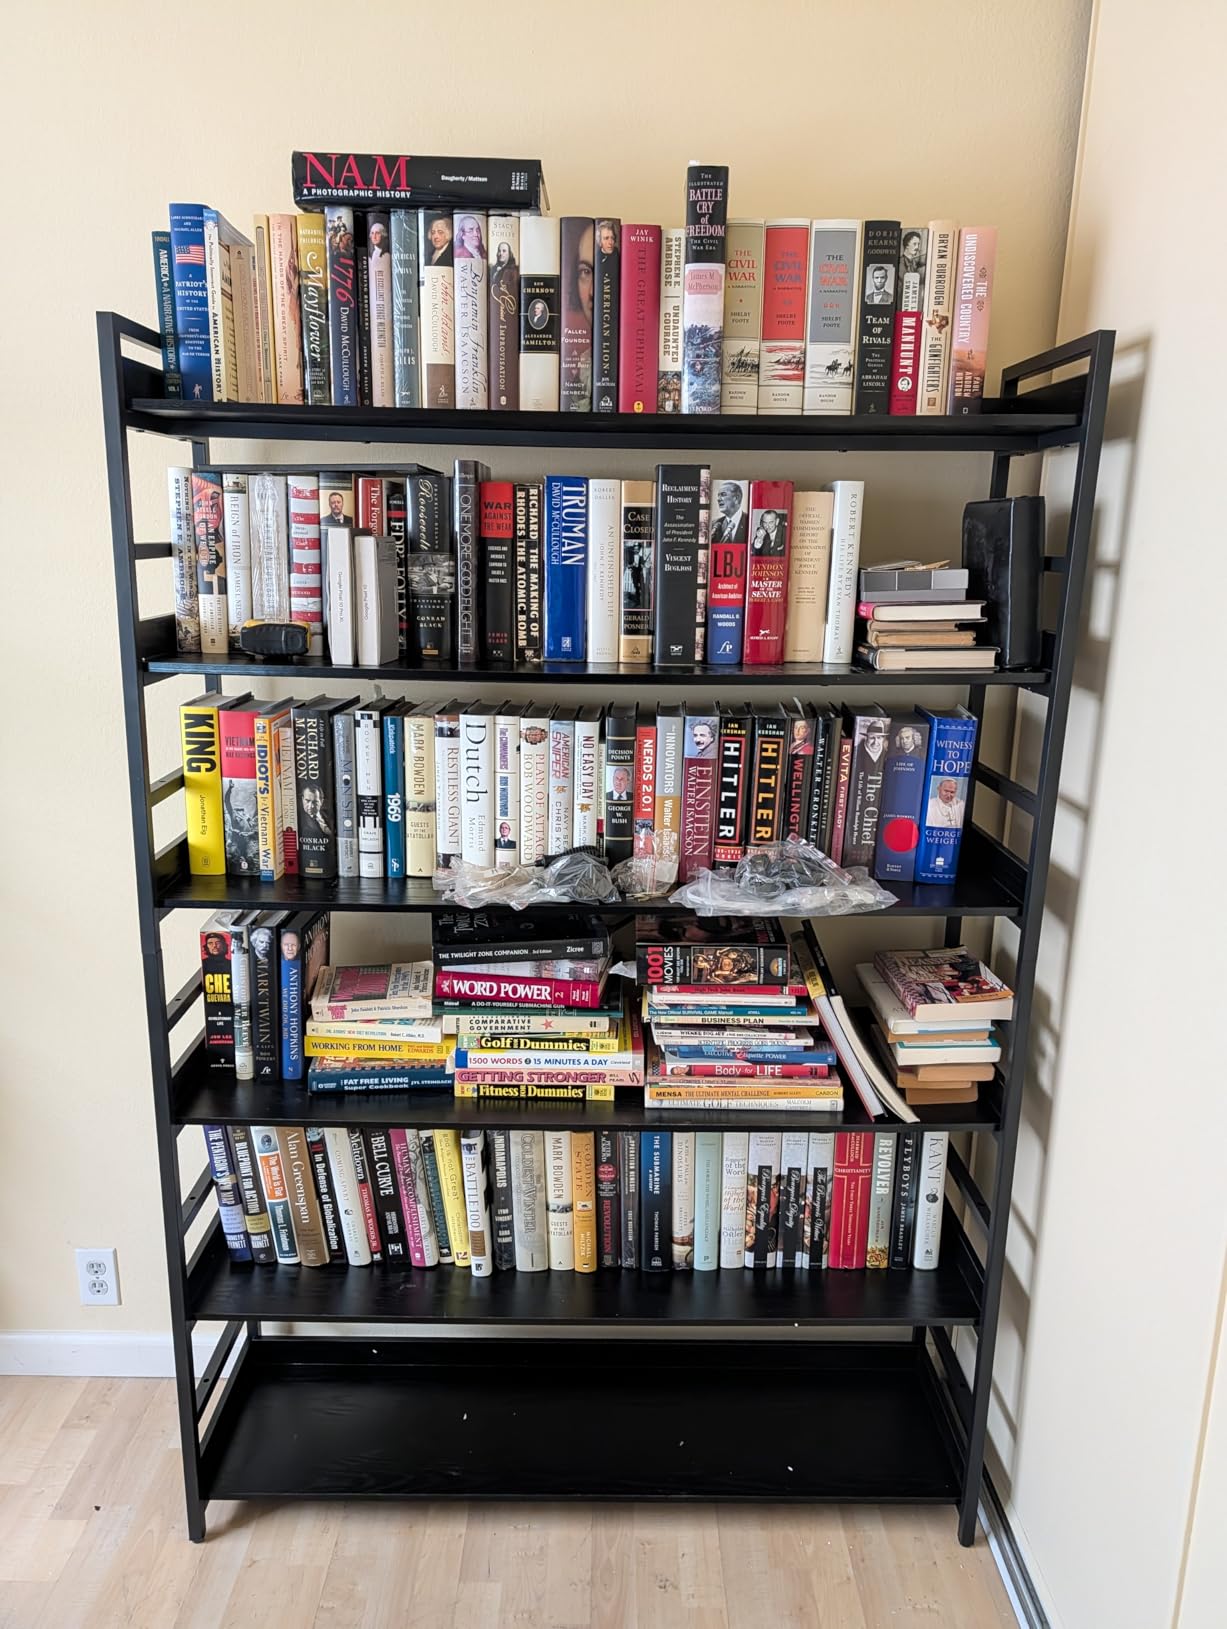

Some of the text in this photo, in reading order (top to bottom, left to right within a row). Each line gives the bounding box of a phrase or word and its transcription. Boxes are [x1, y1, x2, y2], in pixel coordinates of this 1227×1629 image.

[303, 153, 411, 190] NAM
[312, 189, 373, 197] PHOTOGRAPHIC
[690, 190, 722, 200] BATTLE
[697, 202, 713, 213] CRY
[701, 215, 709, 224] of
[630, 235, 654, 243] WINIK
[665, 237, 673, 287] AMBROSE
[728, 260, 757, 269] CIVIL
[728, 272, 756, 281] WAR
[774, 261, 801, 270] CIVIL
[775, 273, 801, 282] WAR
[934, 234, 949, 306] BRYAN BURROUGH
[331, 258, 354, 308] 1776
[959, 234, 977, 343] UNDISCOVERED COUNTRY
[976, 281, 987, 298] THE
[303, 252, 325, 362] Mayflower
[866, 316, 890, 324] TEAM
[460, 264, 469, 394] WALTER ISAACSON
[863, 336, 891, 344] RIVALS
[899, 317, 916, 374] MANHUNT
[517, 491, 525, 536] RHODES
[529, 489, 538, 539] RICHARD
[628, 511, 650, 521] CASE
[667, 495, 692, 504] HISTORY
[561, 483, 586, 565] TRUMAN
[665, 554, 691, 562] VINCENT
[713, 551, 743, 579] LBJ
[844, 493, 858, 599] ROBERT KENNEDY
[751, 580, 782, 588] MASTER
[752, 563, 784, 571] LYNDON
[517, 541, 526, 646] THE ATOMIC BOMB
[530, 548, 538, 637] THE MAKING OF
[184, 713, 216, 773] KING
[295, 718, 307, 779] M. NIXON
[307, 718, 319, 780] RICHARD
[552, 731, 561, 779] SNIPER
[561, 733, 570, 778] AMERICAN
[936, 740, 973, 749] WITNESS
[947, 751, 960, 759] TO
[257, 744, 269, 794] IDIOT'S
[465, 722, 489, 804] Dutch
[582, 736, 594, 800] NO EASY DAY
[642, 739, 653, 812] NERDS 2.0.1
[664, 733, 676, 793] INNOVATORS
[840, 745, 850, 782] EVITA
[933, 760, 970, 773] HOPE
[387, 792, 401, 822] 1969
[447, 747, 460, 846] RESTLESS GIANT
[523, 753, 534, 861] BOB WOODWARD
[719, 742, 742, 838] HITLER
[756, 743, 780, 838] HITLER
[861, 772, 882, 846] The Chief
[663, 800, 673, 826] Walter
[685, 766, 696, 856] WALTER ISAACSON
[693, 766, 713, 856] EINSTEIN
[260, 807, 270, 869] Vietnam War
[468, 817, 477, 849] Morris
[478, 814, 486, 852] Edmund
[205, 974, 231, 993] CHE
[647, 947, 664, 984] 1001
[664, 947, 674, 984] MOVIES
[452, 979, 551, 1000] WORD POWER
[289, 968, 298, 1060] ANTHONY HOPKINS
[311, 1042, 403, 1052] WORKING FROM HOME
[481, 1038, 513, 1049] Golf
[519, 1038, 587, 1050] Dummies
[458, 1072, 606, 1083] GETTING STRONGER
[479, 1085, 519, 1097] Fitness
[527, 1085, 583, 1098] Dummies
[314, 1153, 324, 1162] In
[350, 1132, 365, 1180] Meltdown
[370, 1136, 388, 1162] BELL
[494, 1136, 507, 1188] INDIANAPOLIS
[876, 1139, 893, 1194] REVOLVER
[901, 1139, 912, 1197] FLYBOYS
[928, 1138, 943, 1183] KANT
[286, 1131, 310, 1223] Alan Greenspan
[315, 1163, 328, 1193] Defense
[375, 1163, 394, 1196] CURVE
[552, 1138, 563, 1199] MARK BOWDEN
[322, 1204, 338, 1250] Globalization
